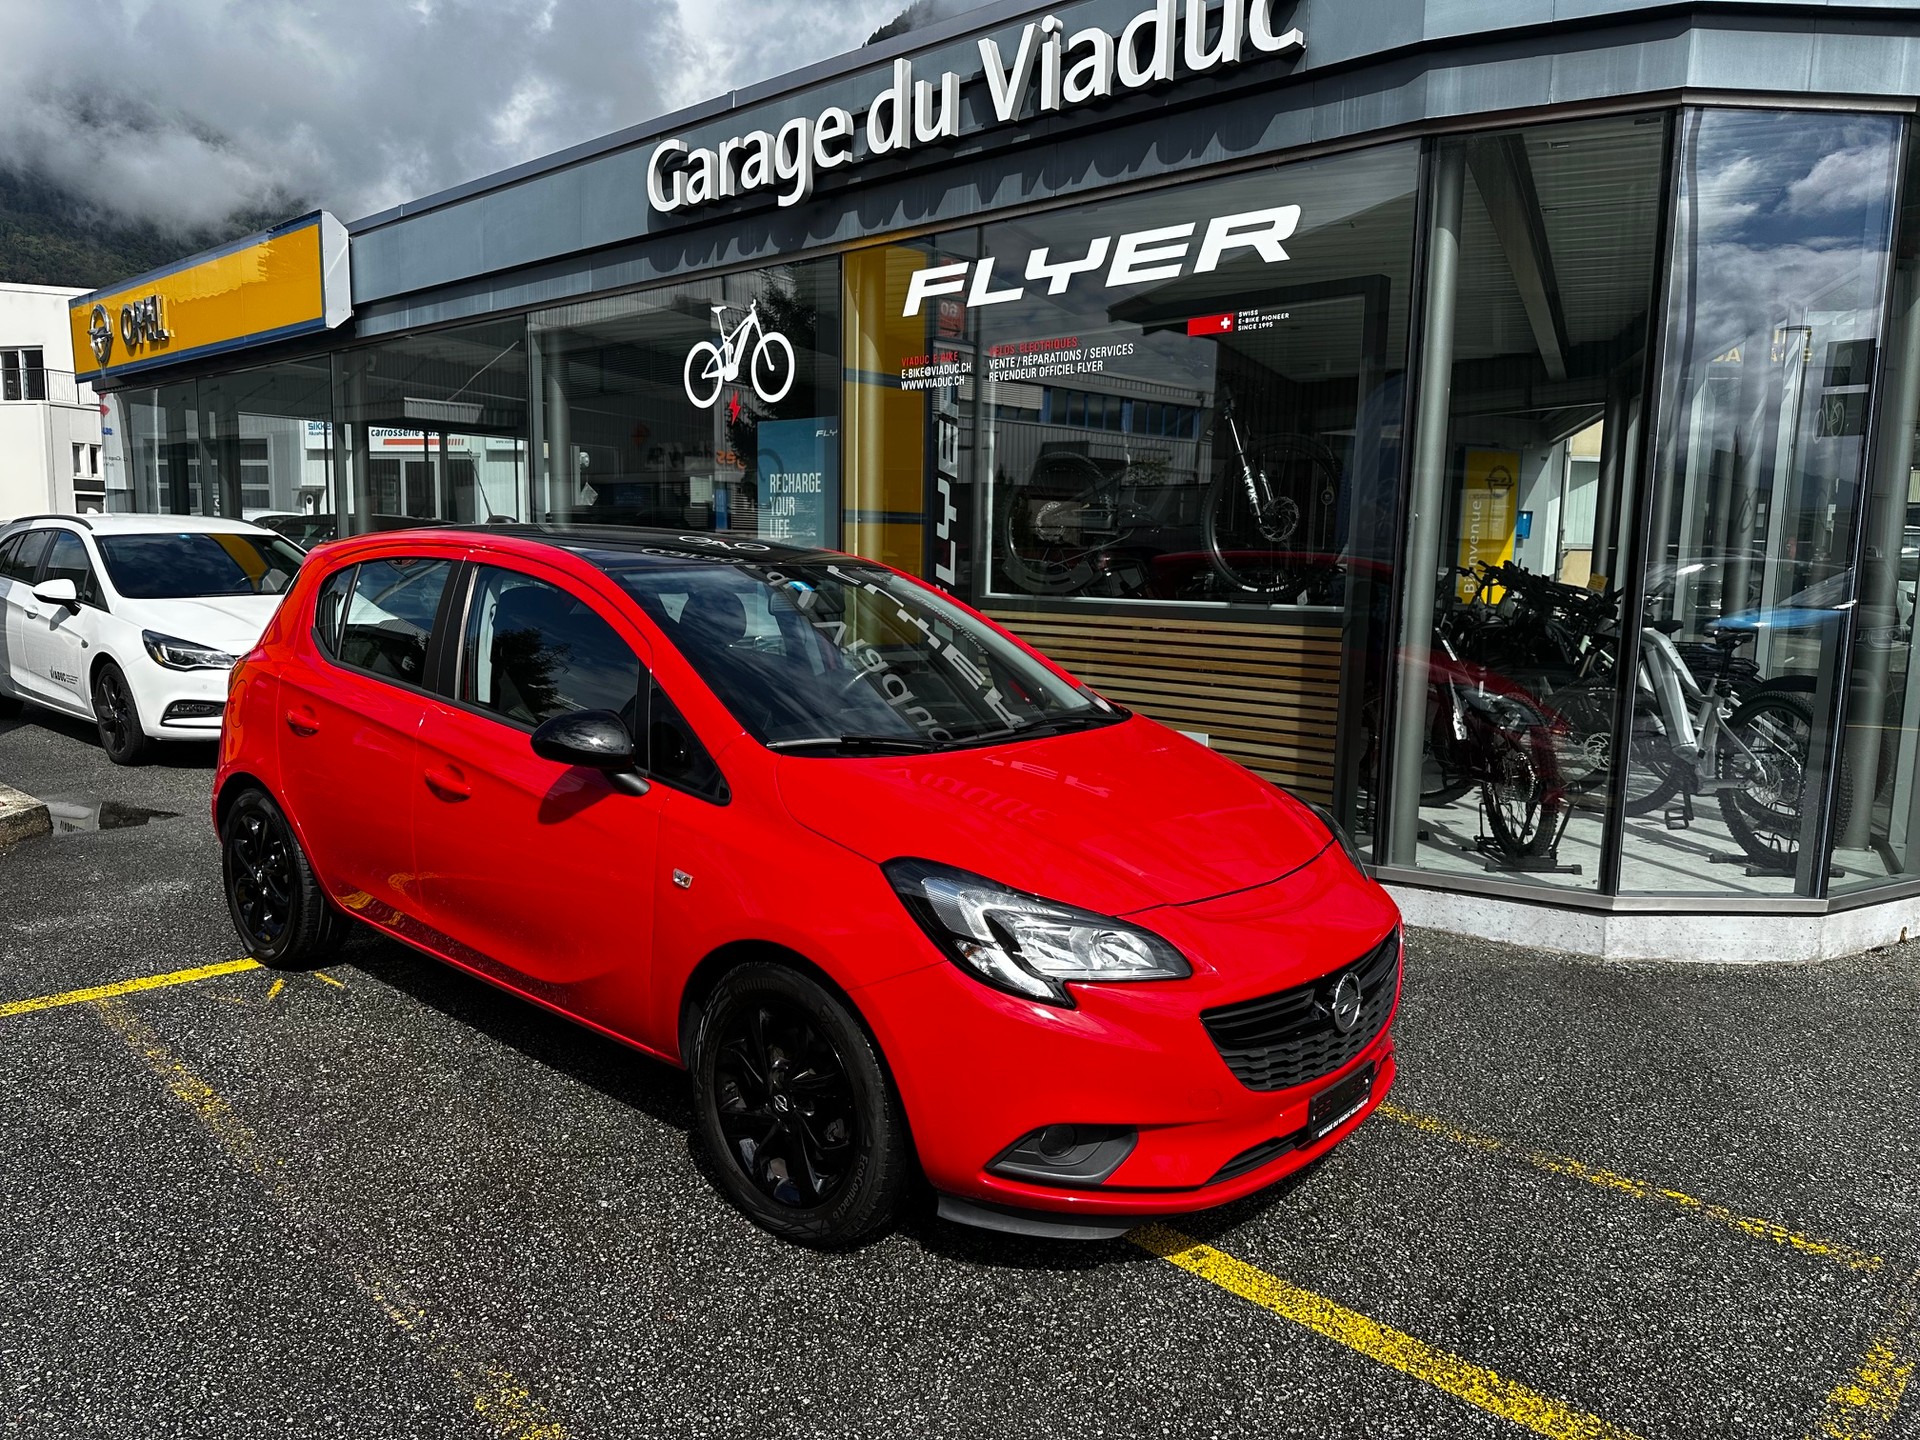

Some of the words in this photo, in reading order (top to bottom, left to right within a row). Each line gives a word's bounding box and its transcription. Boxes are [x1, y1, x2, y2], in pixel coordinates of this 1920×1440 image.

[646, 107, 853, 214] Garage
[866, 58, 960, 155] du
[977, 0, 1305, 122] Viaduc
[902, 204, 1301, 317] FLYER
[1237, 316, 1260, 325] E-BIKE
[1261, 312, 1290, 321] PIONEER
[1238, 309, 1259, 318] SWISS
[1237, 323, 1257, 331] SINCE
[1258, 321, 1274, 329] 1995
[901, 355, 930, 367] VIADUC
[933, 351, 959, 363] E-BIKE
[988, 356, 1015, 370] VENTE
[1022, 348, 1082, 366] RÉPARATIONS
[1090, 343, 1134, 359] SERVICES
[901, 362, 972, 379] E-BIKE@VIADUC.CH
[988, 367, 1037, 382] REVENDEUR
[1039, 363, 1075, 378] OFFICIEL
[1077, 360, 1103, 374] FLYER
[370, 427, 420, 437] carrosserie
[769, 472, 822, 494] RECHARGE
[769, 496, 796, 517] YOUR
[769, 518, 794, 539] LIFE.
[1463, 499, 1483, 594] Binvenue
